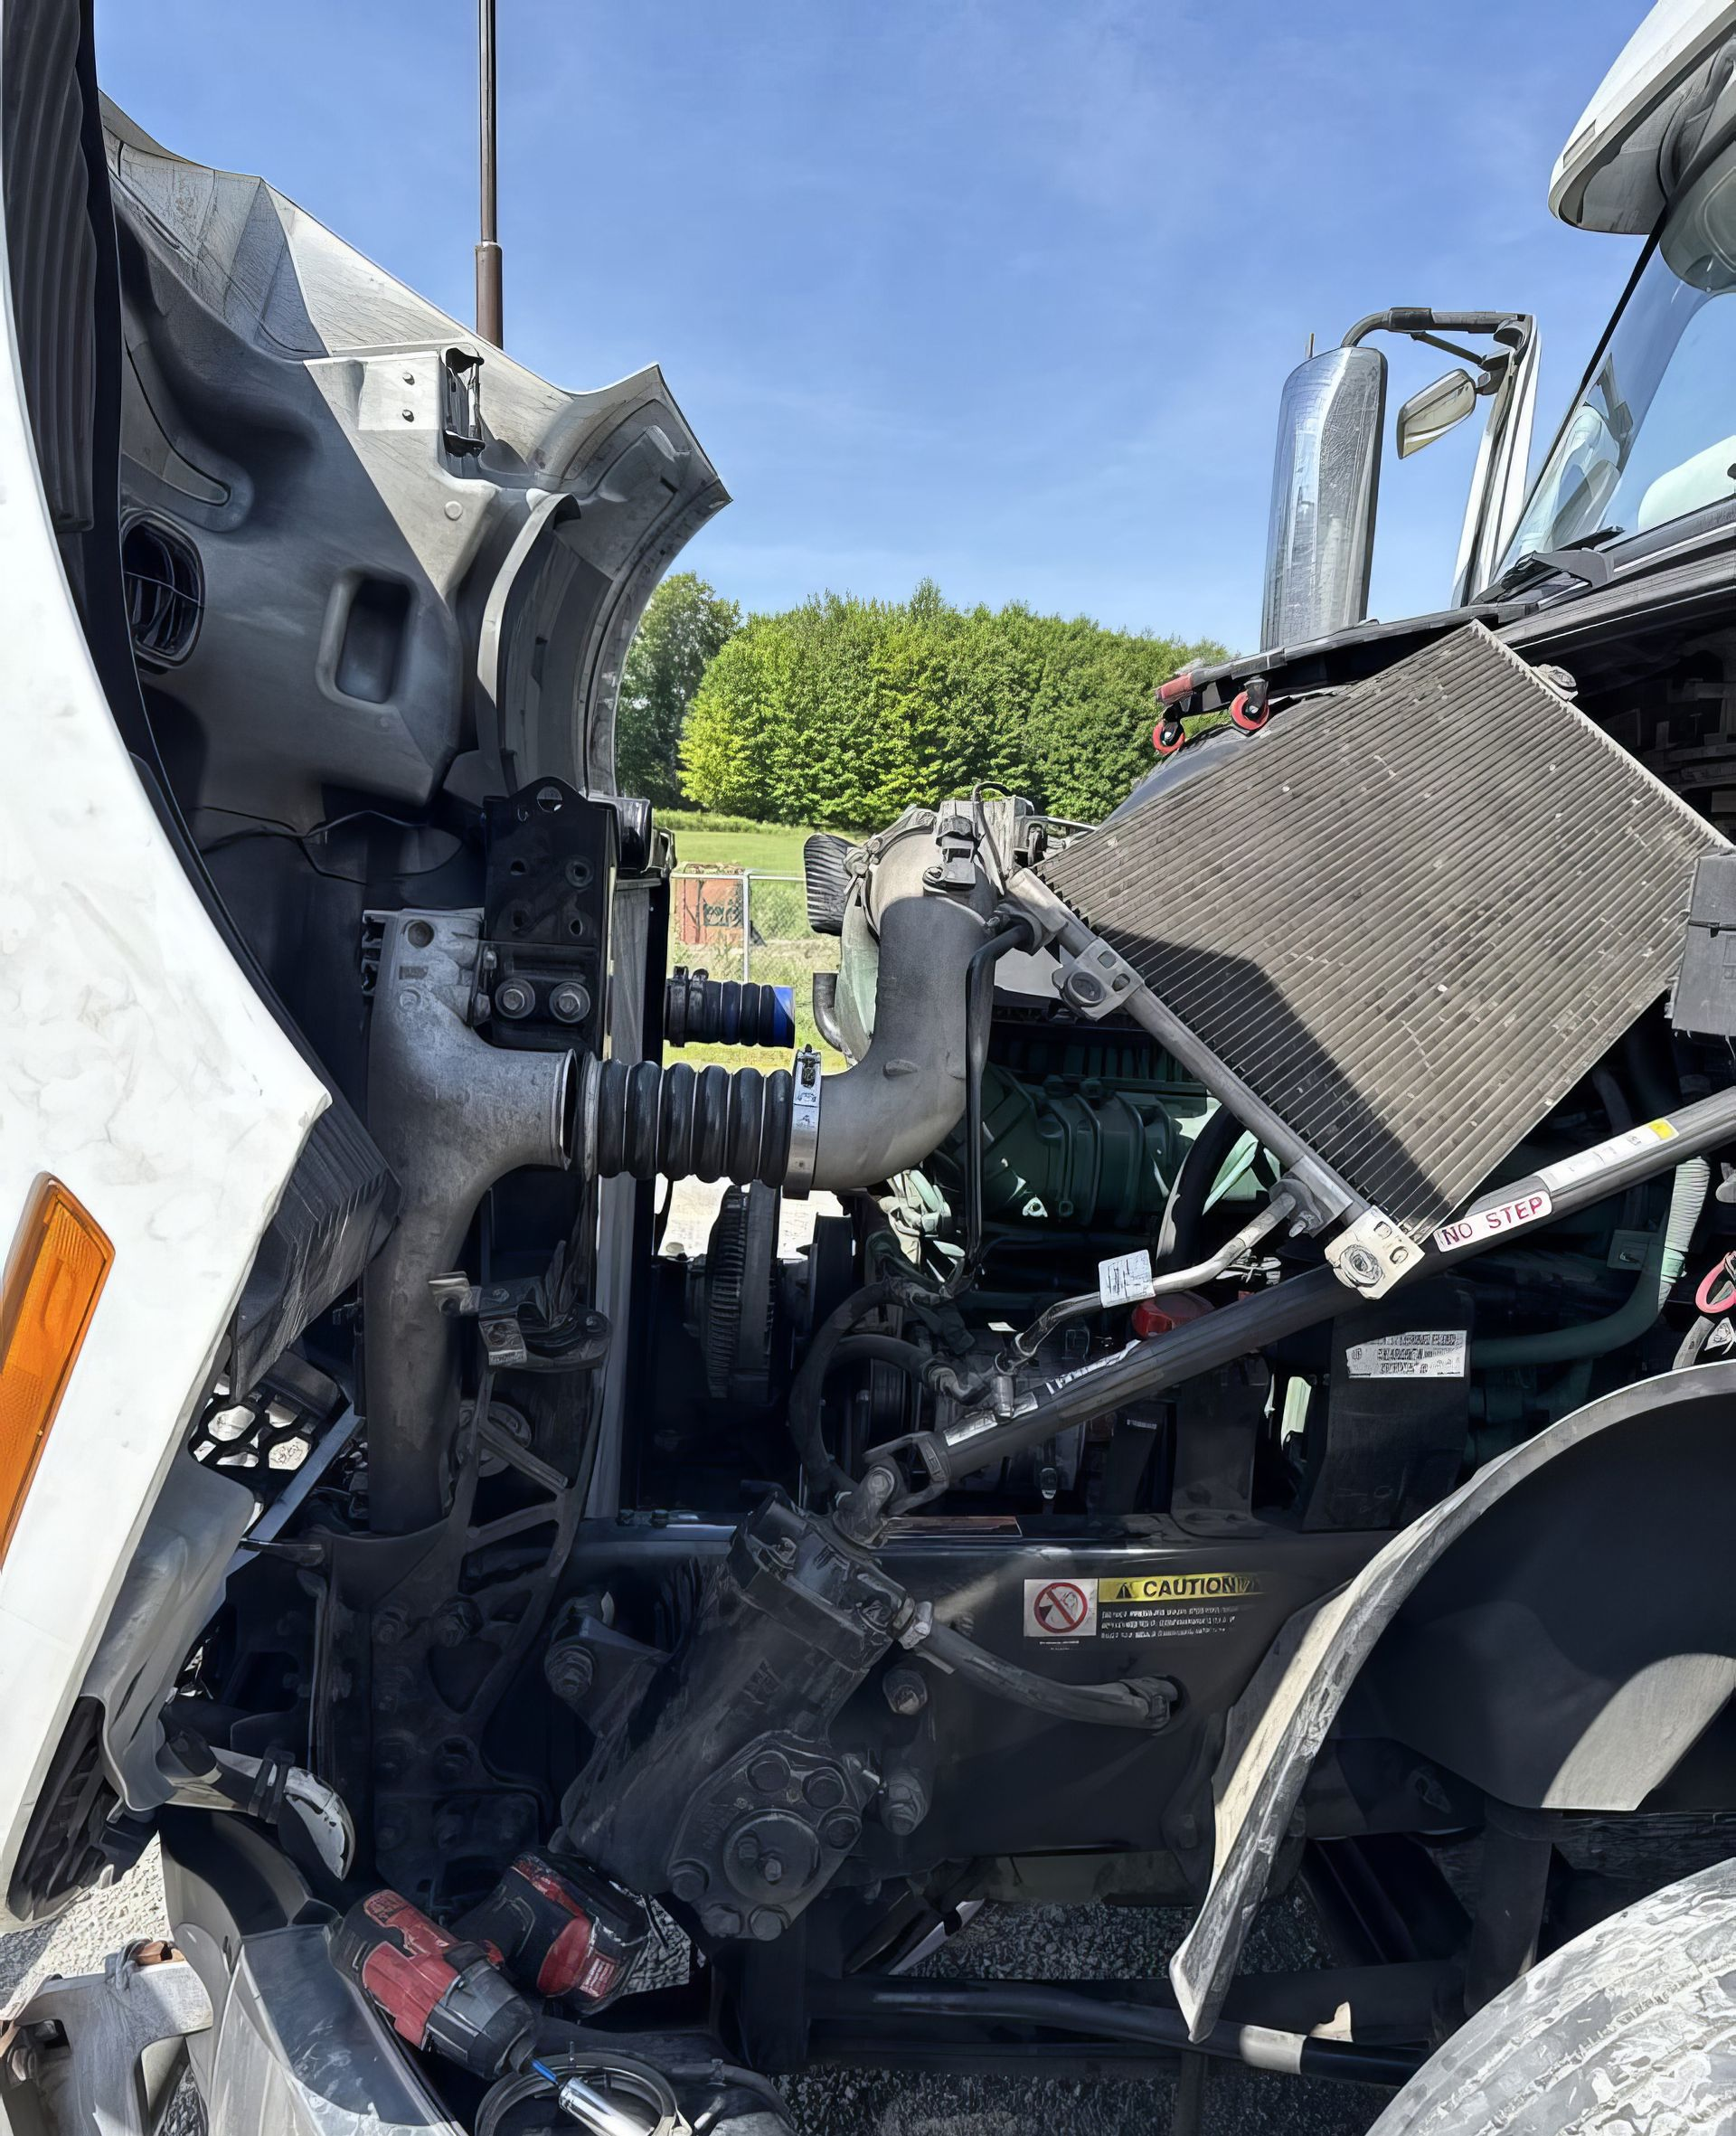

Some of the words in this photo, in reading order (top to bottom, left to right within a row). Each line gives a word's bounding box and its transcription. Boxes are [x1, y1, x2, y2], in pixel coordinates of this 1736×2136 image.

[1441, 1223, 1473, 1245] NO
[1486, 1196, 1543, 1229] STEP
[1143, 1576, 1236, 1597] CAUTION
